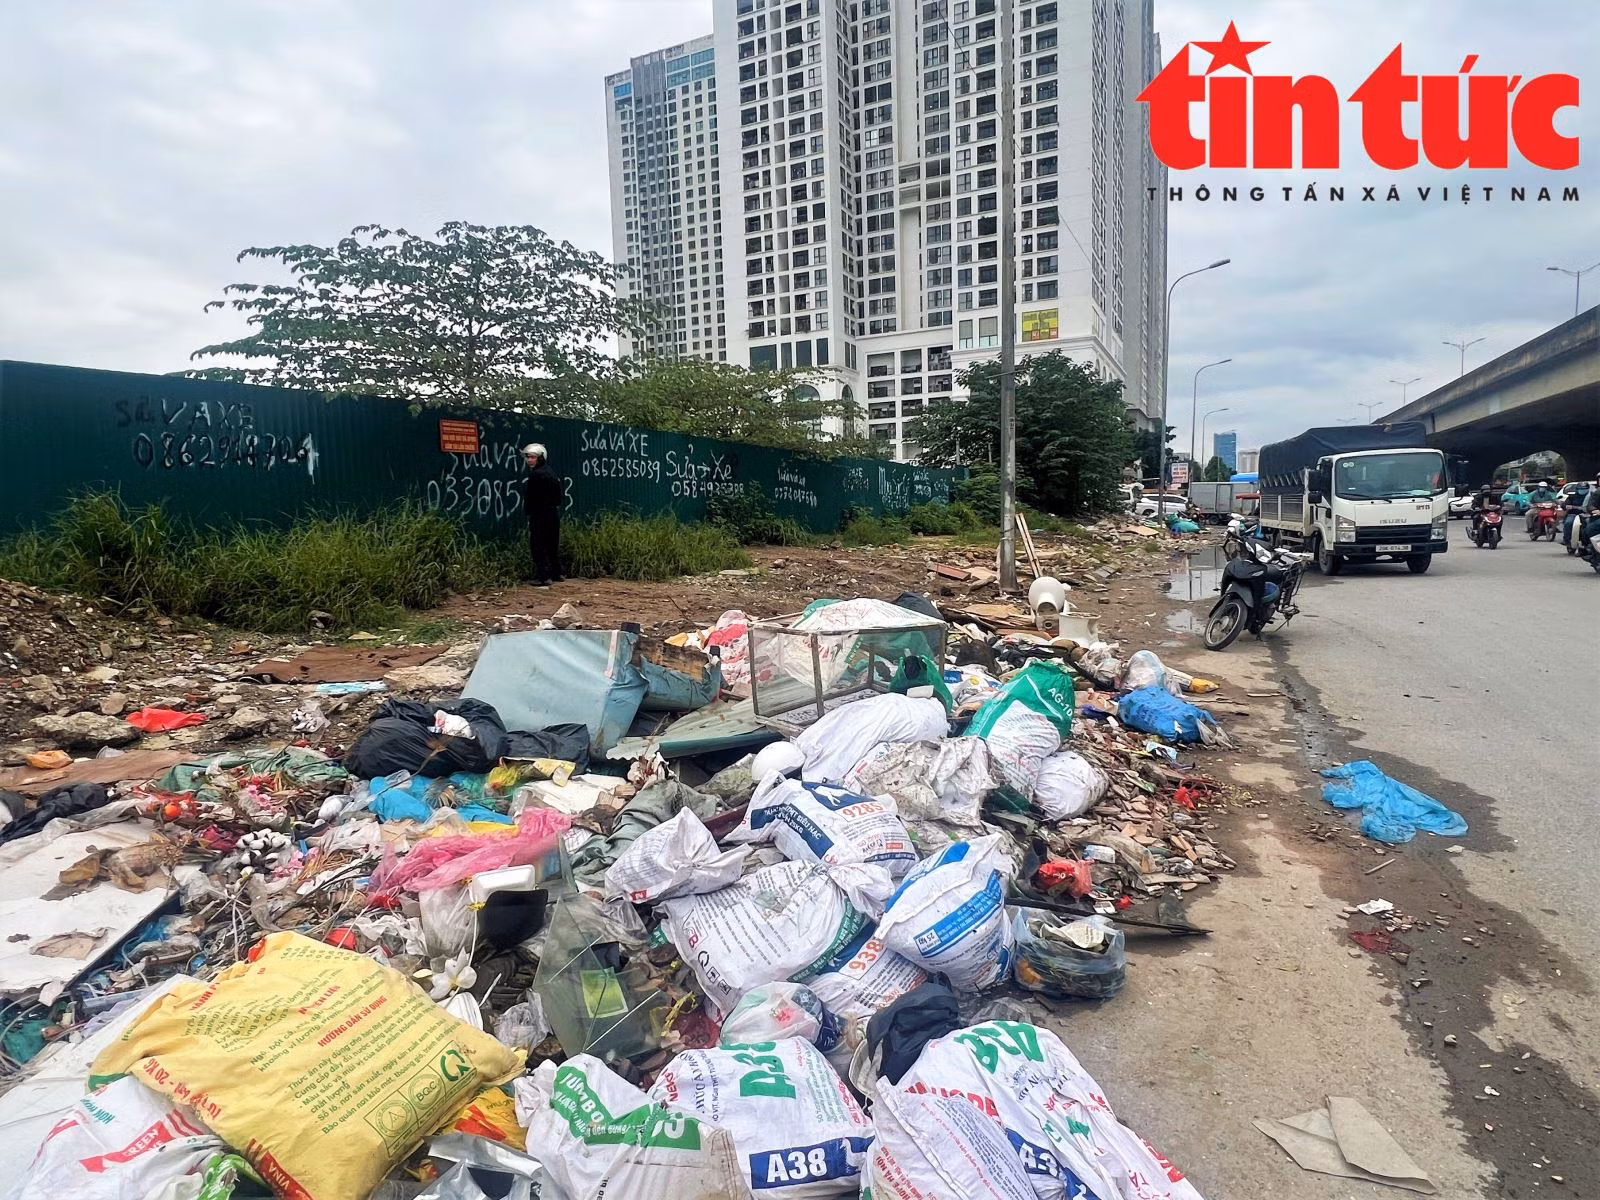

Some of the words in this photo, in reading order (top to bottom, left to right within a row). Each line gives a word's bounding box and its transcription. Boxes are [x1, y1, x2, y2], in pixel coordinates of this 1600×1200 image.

[926, 932, 934, 941] 25
[318, 1022, 346, 1047] HƯỚNG
[288, 1074, 307, 1090] Thức
[308, 1066, 318, 1076] ăn
[349, 1035, 361, 1046] cho
[153, 1067, 169, 1084] 20
[415, 1080, 438, 1102] BQC
[558, 1071, 606, 1124] JUMBO
[766, 1147, 828, 1184] A38
